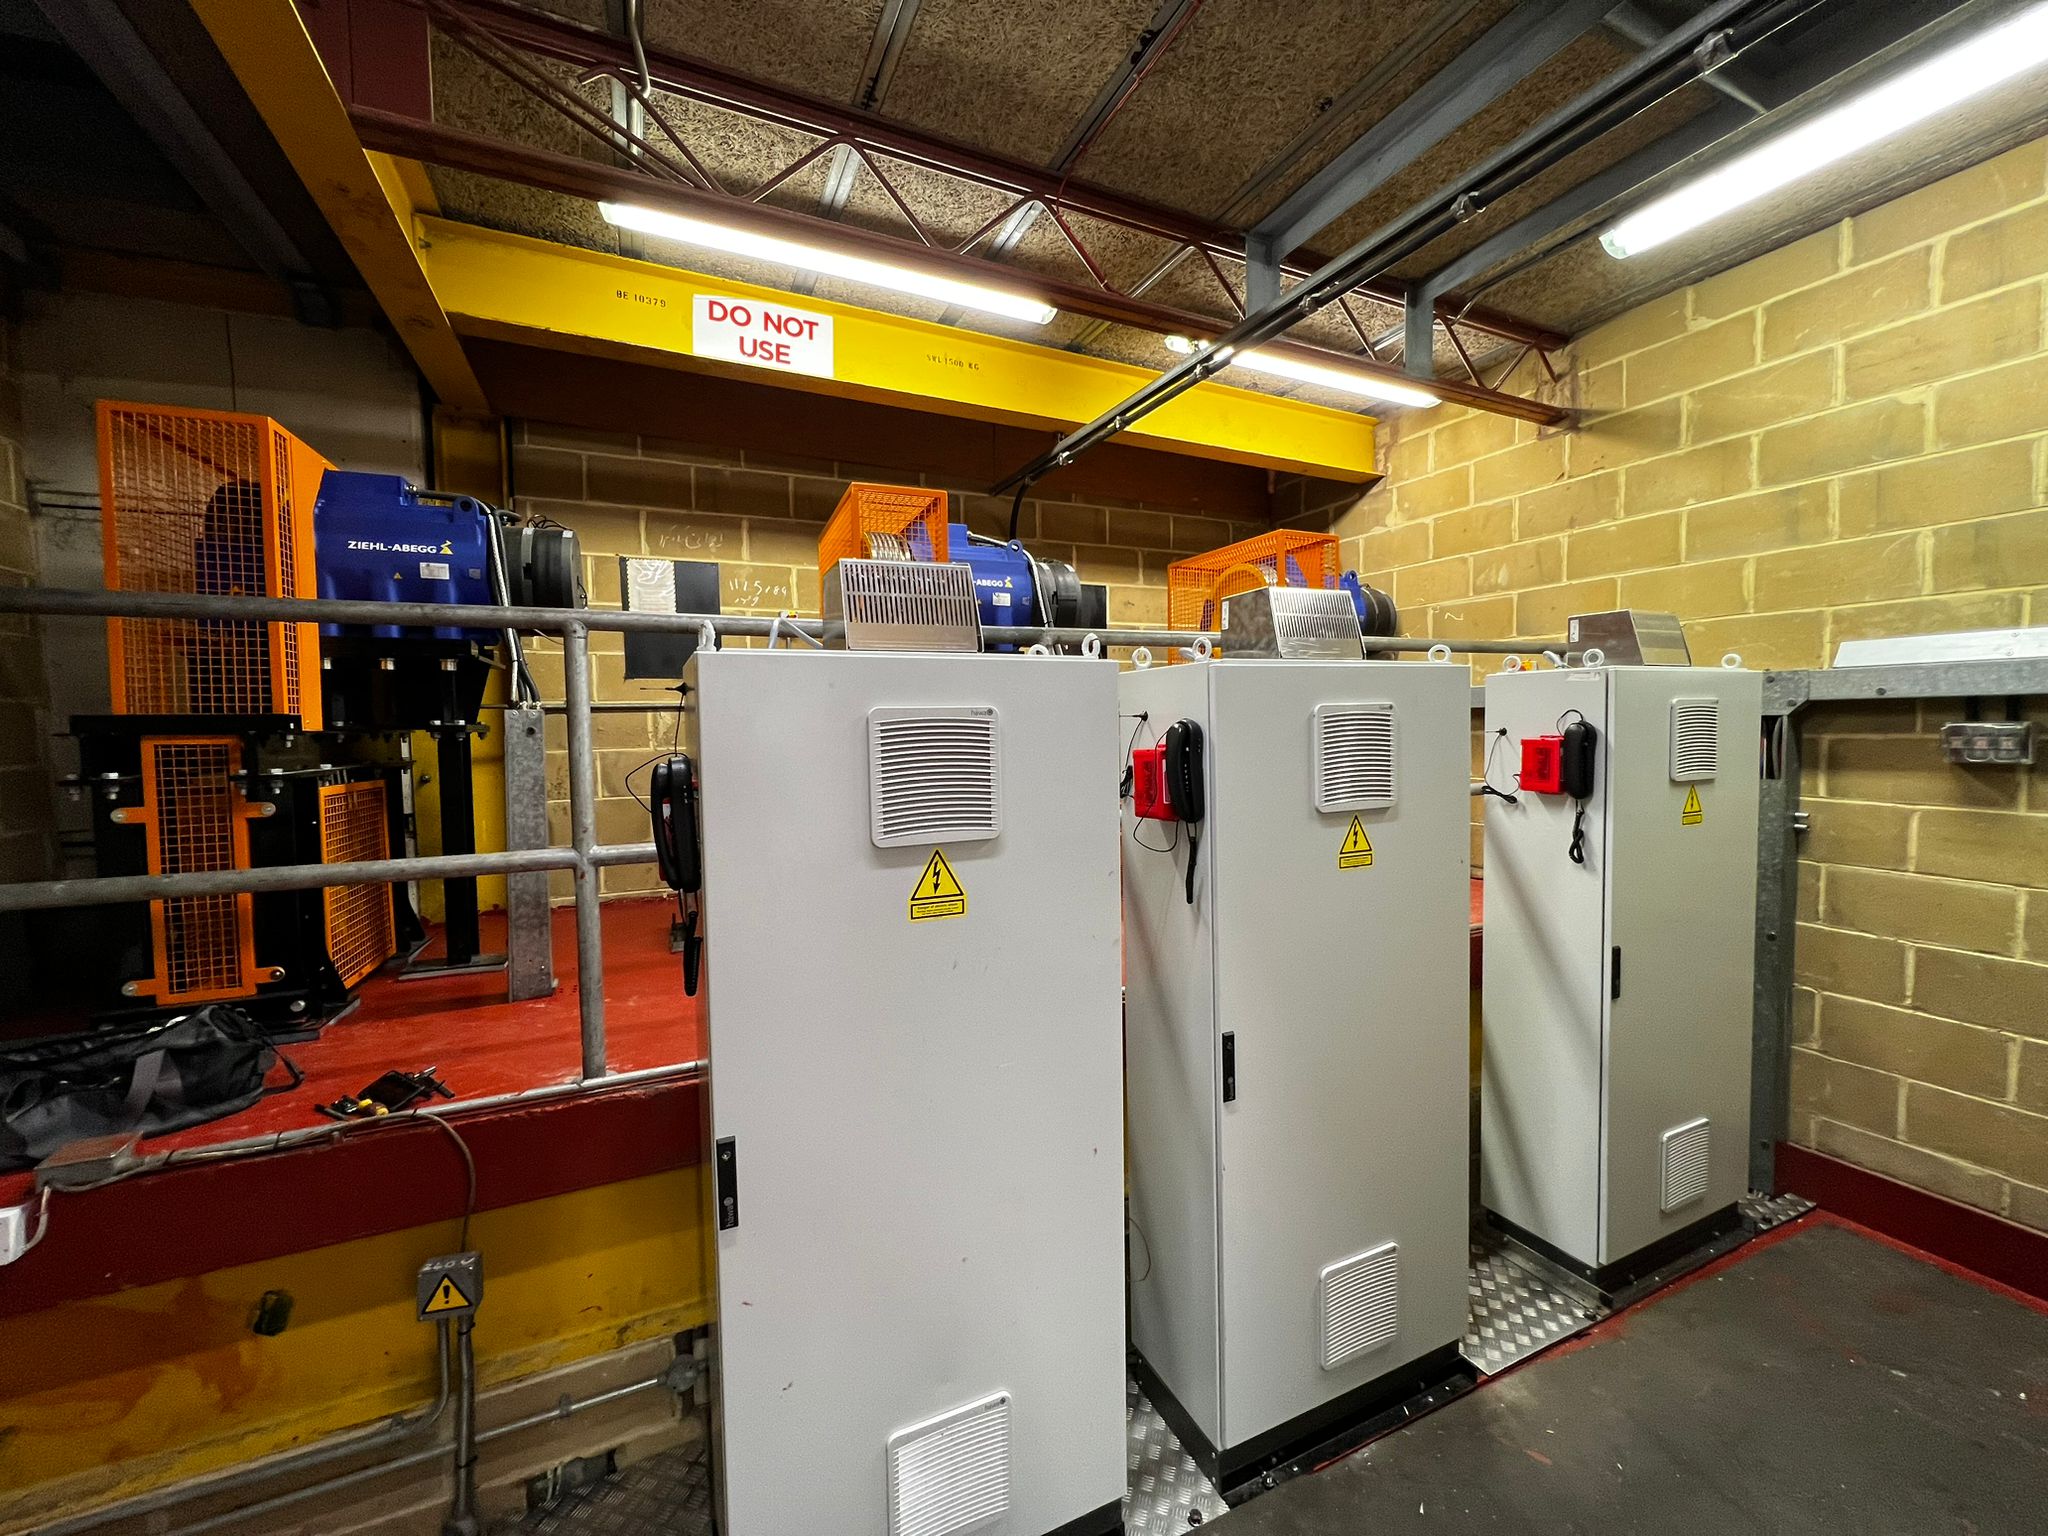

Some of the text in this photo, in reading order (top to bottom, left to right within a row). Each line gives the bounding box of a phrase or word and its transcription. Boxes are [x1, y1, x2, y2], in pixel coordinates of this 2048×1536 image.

[616, 289, 666, 308] BE 10379
[708, 299, 819, 340] DO NOT
[739, 335, 791, 364] USE
[347, 540, 437, 554] ZIEHL-ABEGG
